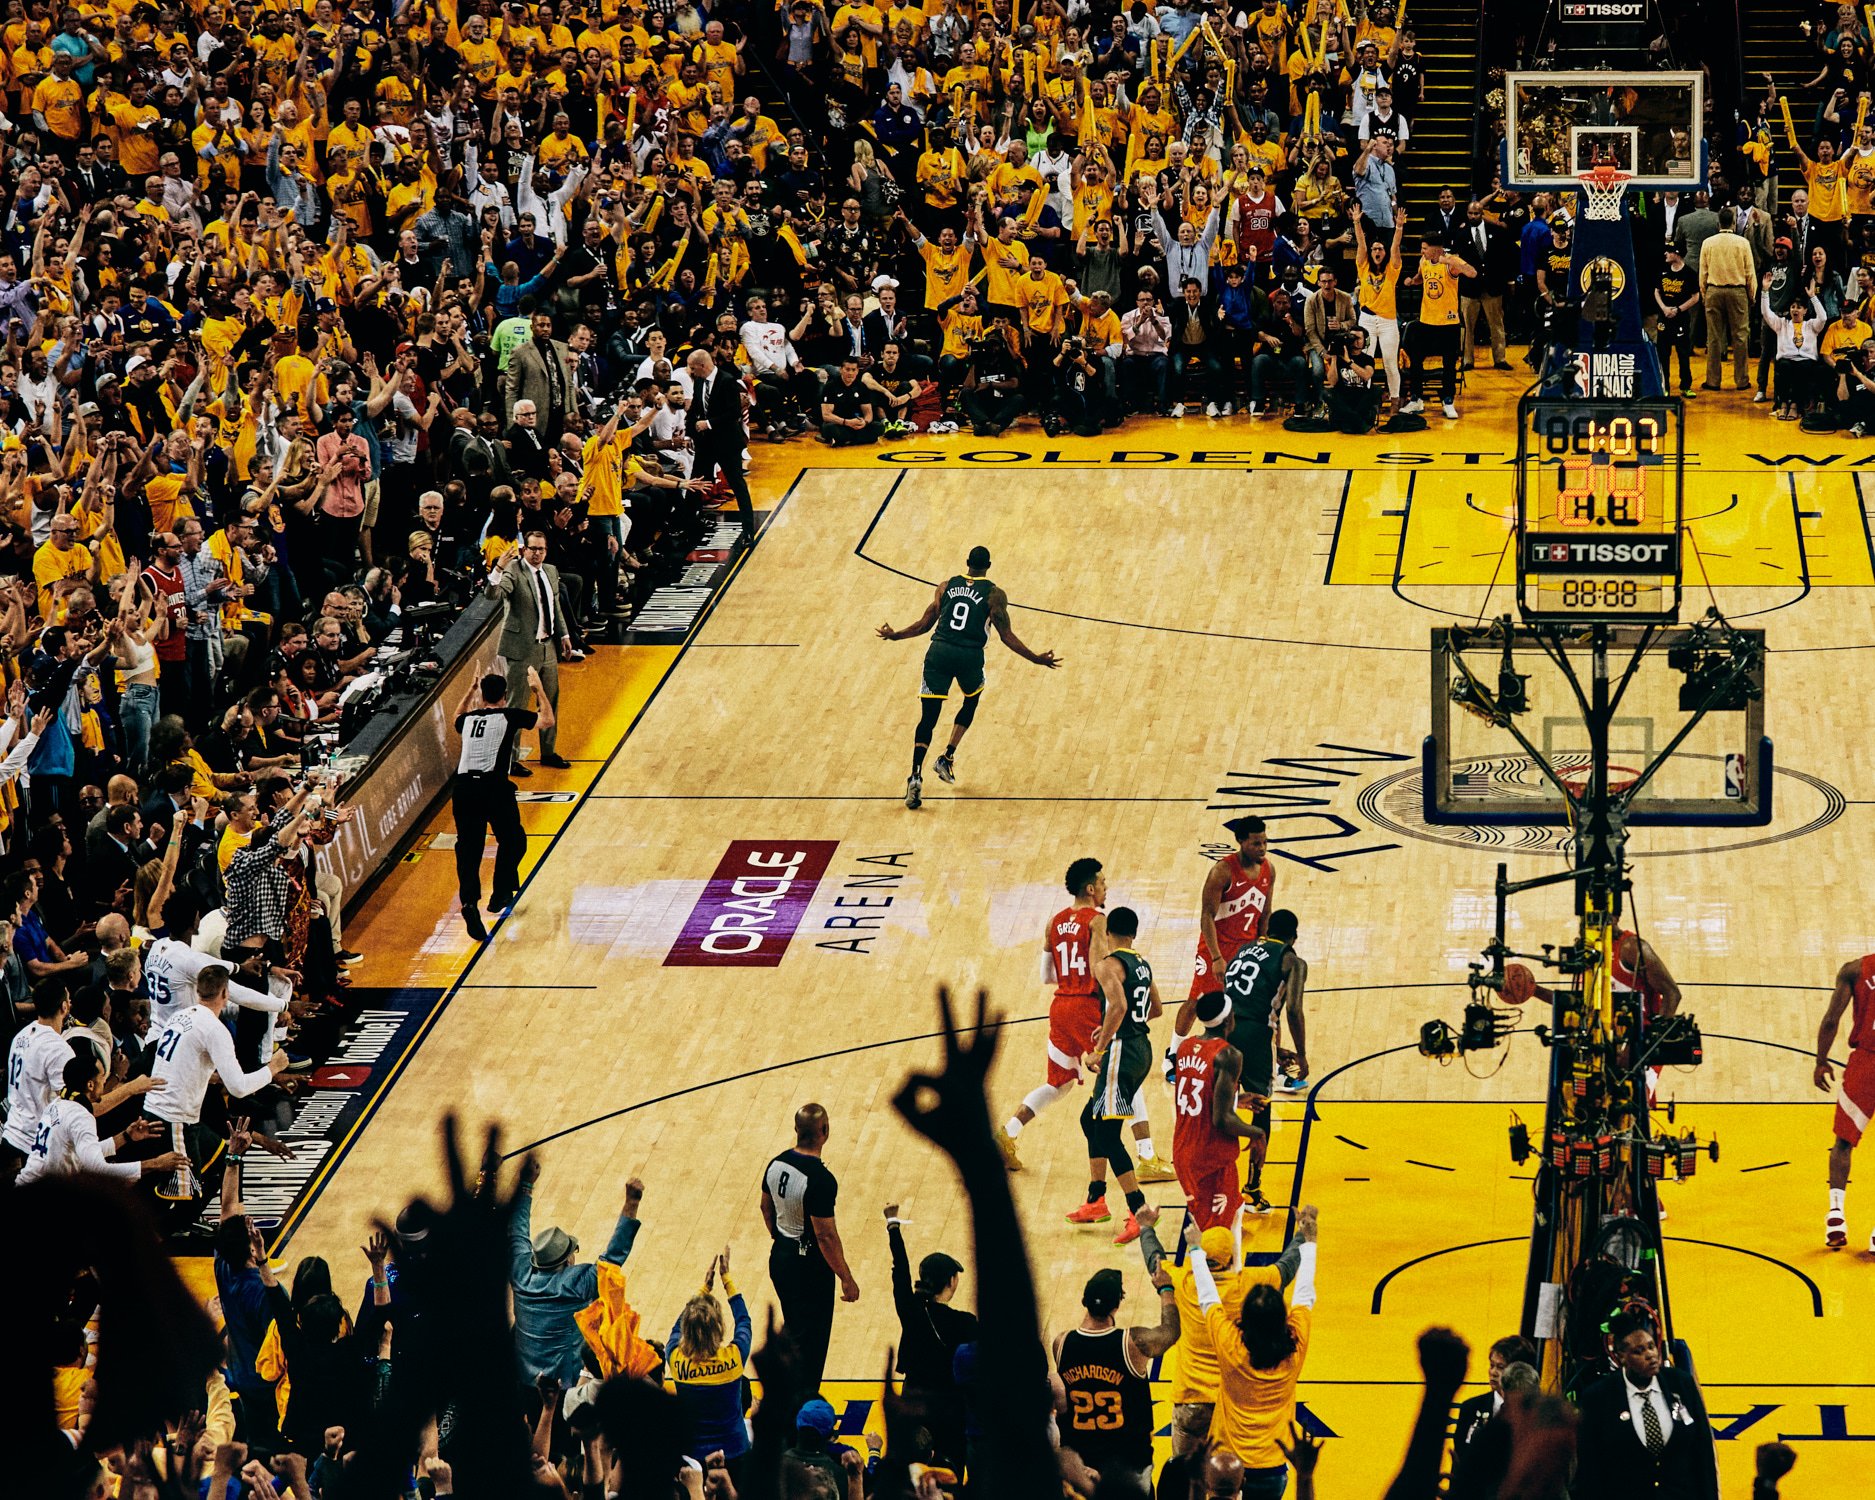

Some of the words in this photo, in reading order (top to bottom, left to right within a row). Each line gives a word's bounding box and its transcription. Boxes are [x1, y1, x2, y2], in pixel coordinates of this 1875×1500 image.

[1586, 4, 1643, 15] TISSOT
[1402, 73, 1409, 82] 9
[1250, 217, 1269, 230] 20
[1428, 281, 1439, 290] 35
[1593, 353, 1619, 376] NBA
[1618, 353, 1635, 376] 2019
[877, 450, 1332, 464] GOLDEN
[1570, 544, 1669, 563] TISSOT
[947, 586, 984, 606] IGUODALA
[949, 601, 970, 631] 9
[470, 719, 487, 738] 16
[1206, 743, 1417, 873] TOWN
[700, 850, 808, 955] ORACLE
[815, 851, 914, 954] ARENA
[1056, 921, 1081, 936] GREEN
[1243, 912, 1256, 932] 7
[1055, 941, 1087, 976] 14
[146, 971, 172, 1005] 35
[1225, 959, 1261, 996] 23
[1131, 986, 1152, 1023] 30
[156, 1028, 182, 1062] 21
[9, 1052, 24, 1090] 12
[1178, 1055, 1208, 1075] SIAKAM
[274, 1099, 348, 1136] Presented
[324, 1022, 401, 1065] YouTube
[1177, 1076, 1205, 1117] 43
[778, 1170, 790, 1199] 8
[674, 1358, 738, 1381] Warriors
[1062, 1364, 1125, 1386] RICHARDSON
[1069, 1390, 1125, 1431] 23
